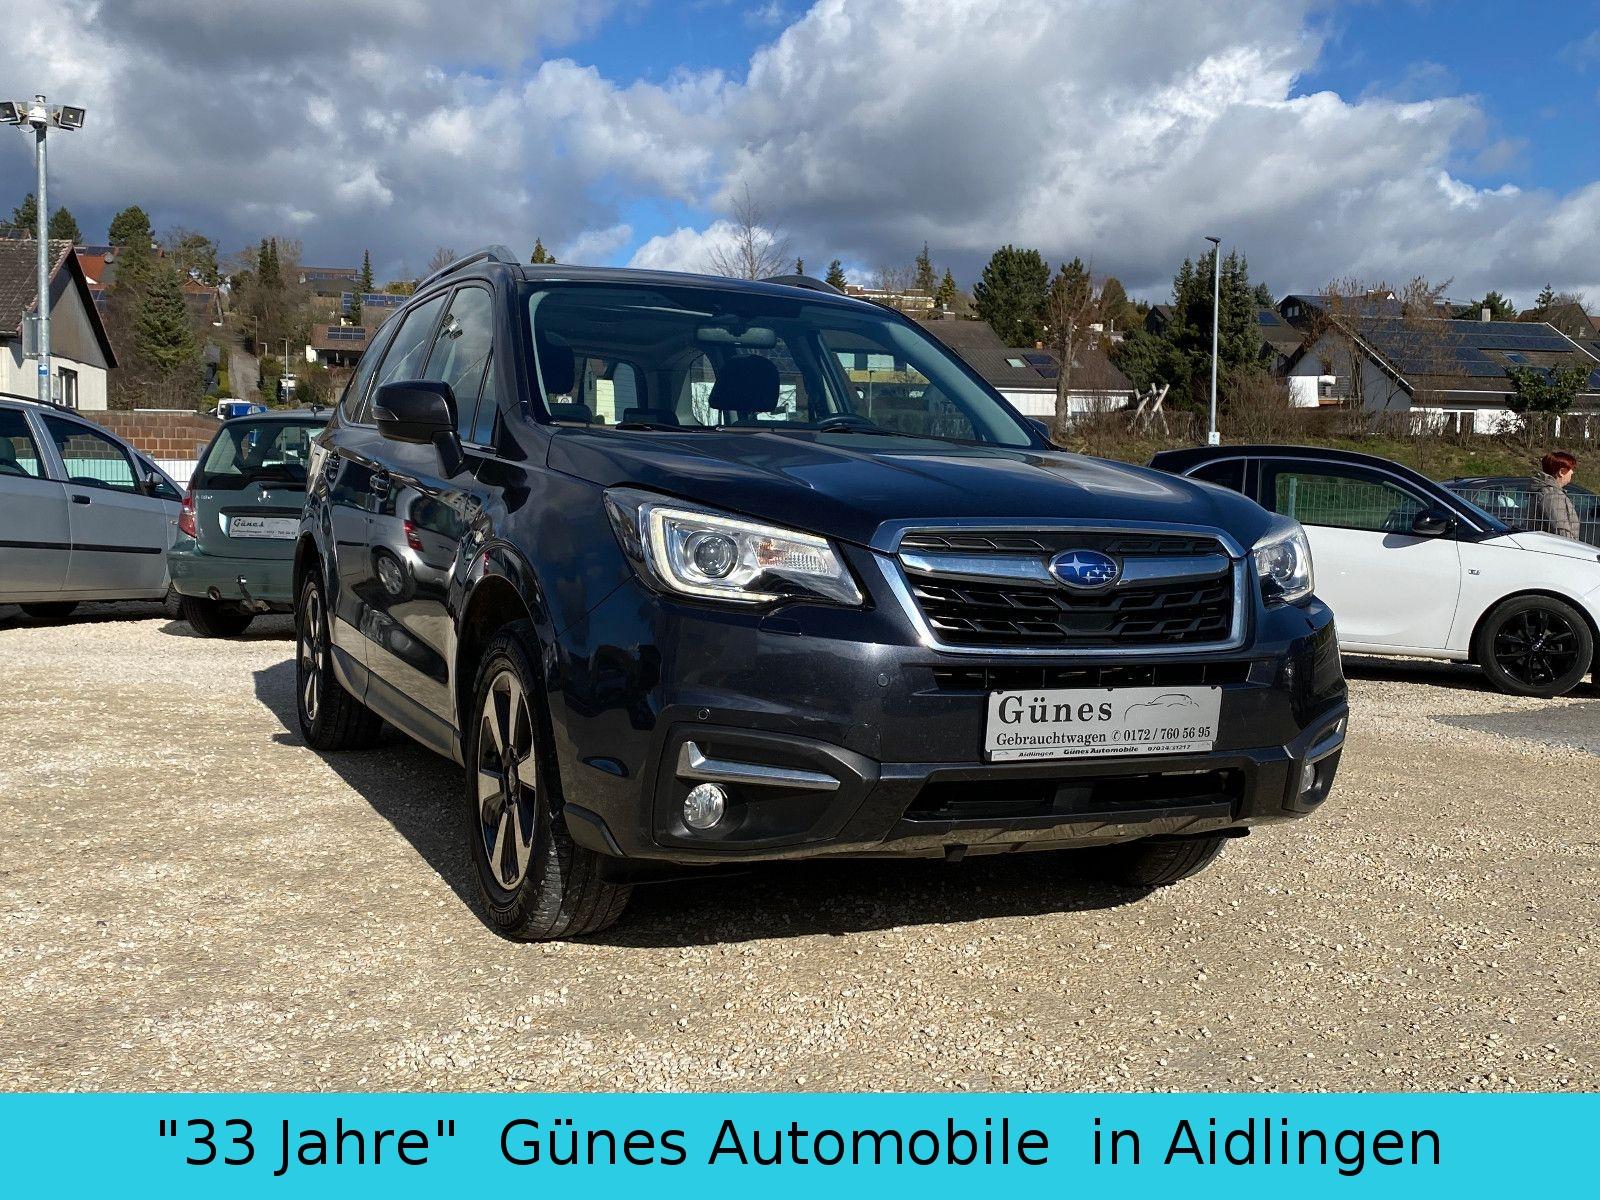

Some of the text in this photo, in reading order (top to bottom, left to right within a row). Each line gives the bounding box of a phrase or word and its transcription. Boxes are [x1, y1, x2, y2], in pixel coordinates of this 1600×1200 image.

[998, 695, 1113, 724] Günes
[996, 731, 1106, 747] Gebrauchtwagen
[1123, 728, 1151, 741] 0172
[1160, 727, 1180, 740] 760
[1182, 726, 1196, 739] 56
[1198, 726, 1211, 738] 95
